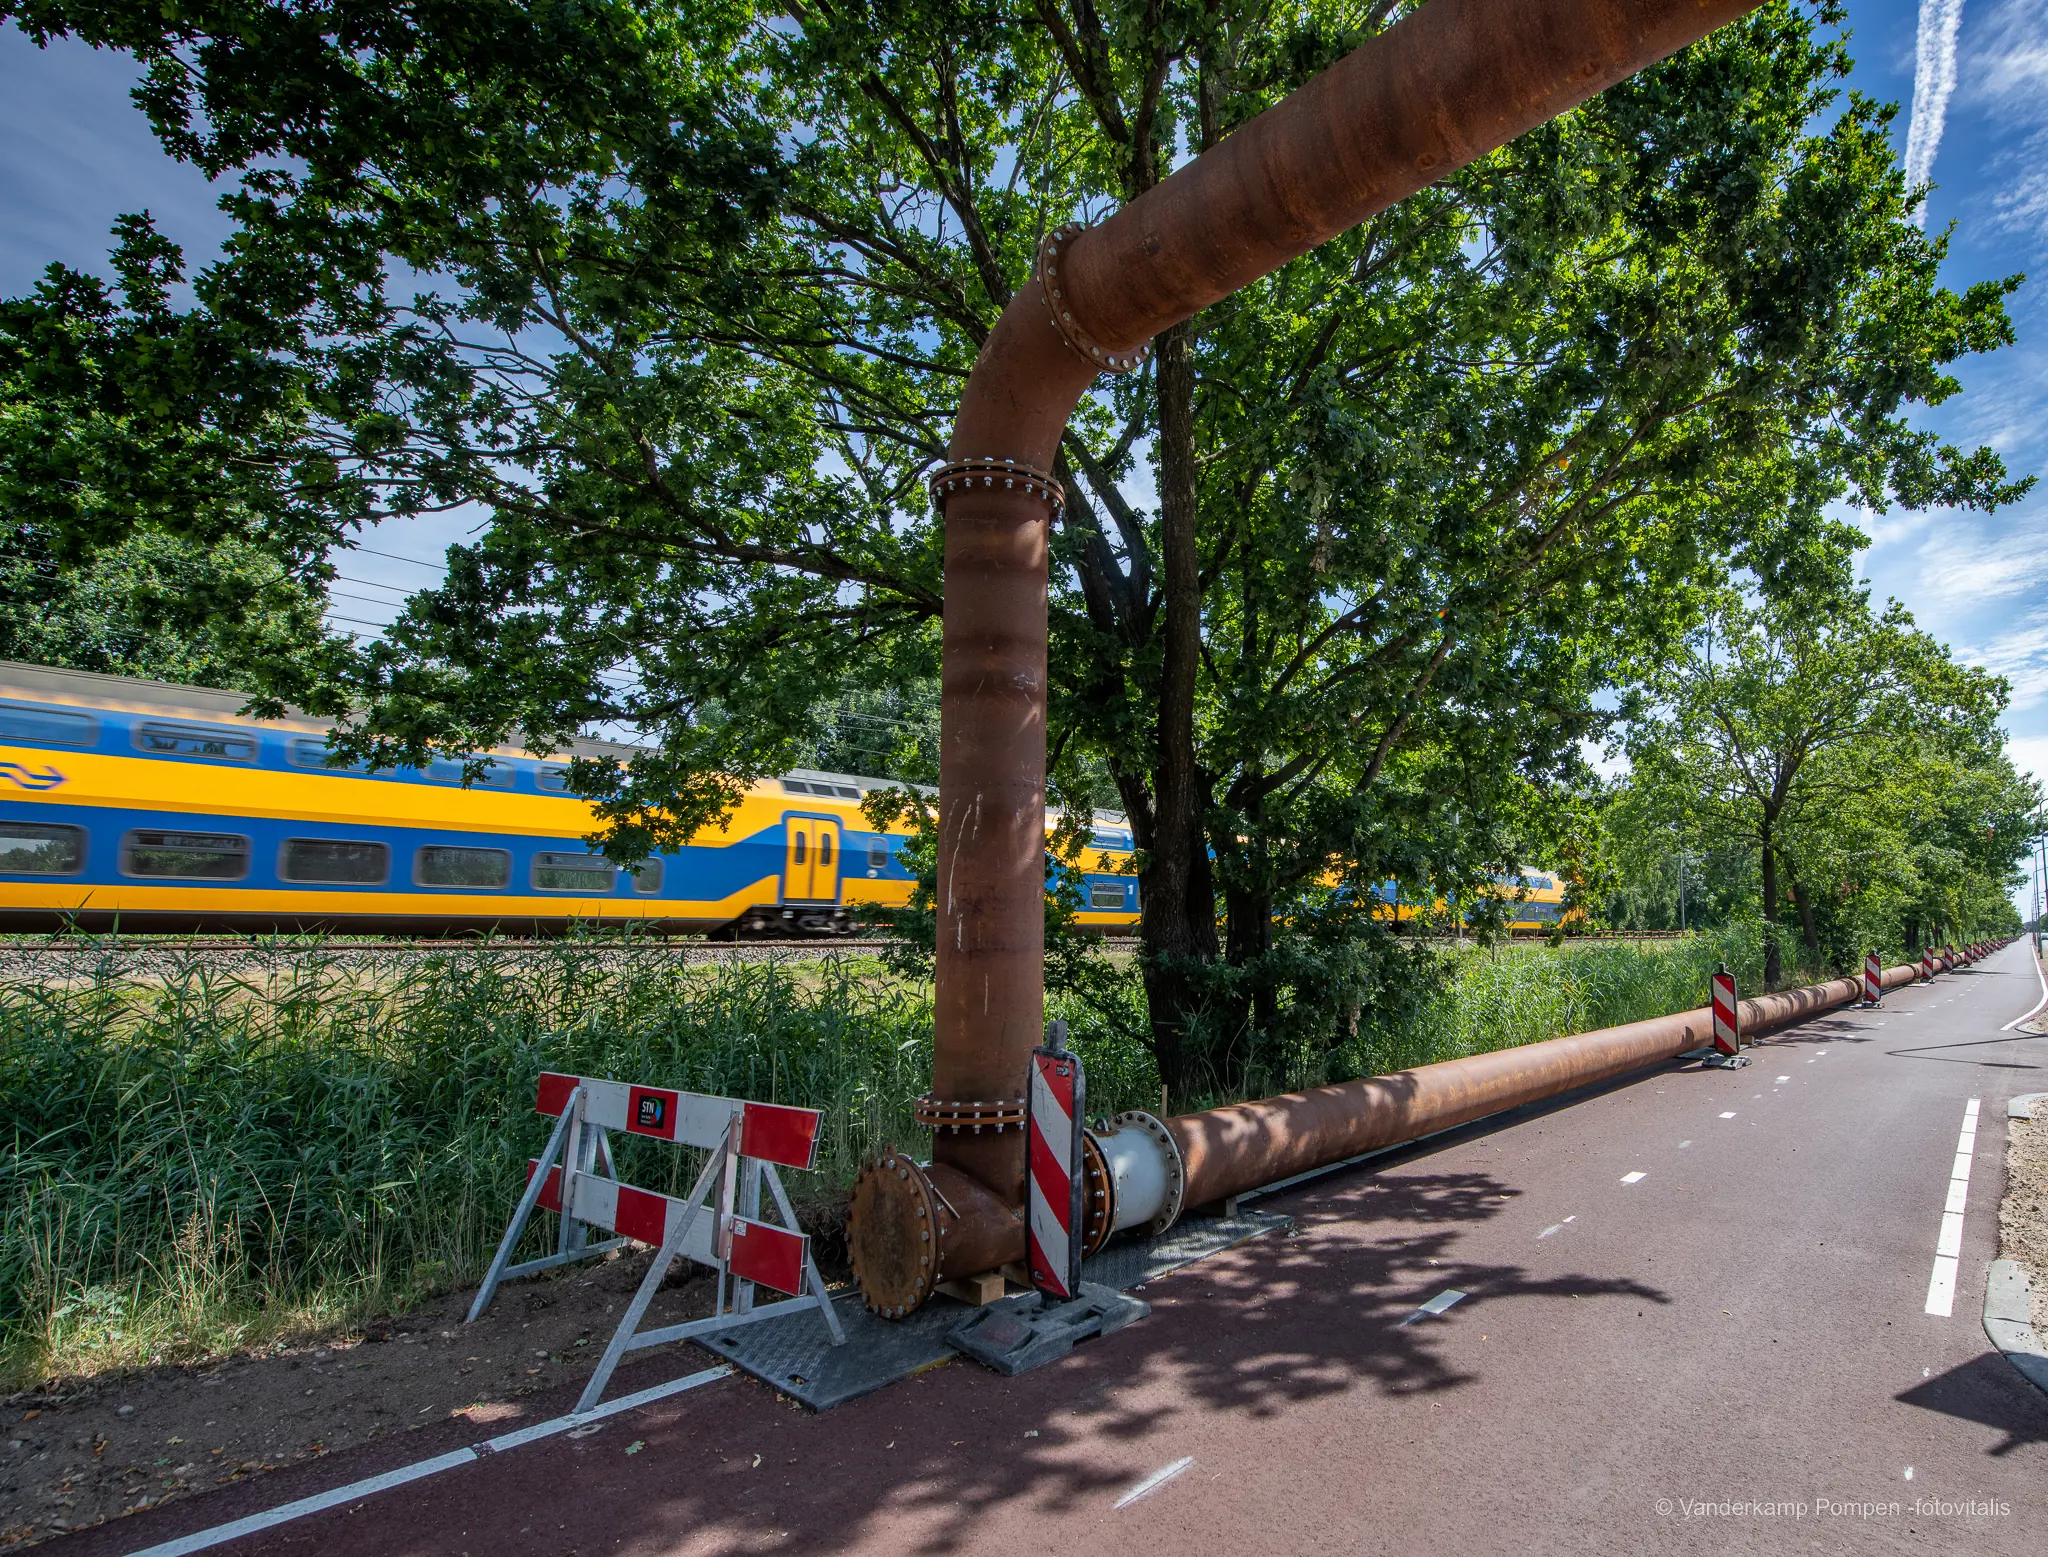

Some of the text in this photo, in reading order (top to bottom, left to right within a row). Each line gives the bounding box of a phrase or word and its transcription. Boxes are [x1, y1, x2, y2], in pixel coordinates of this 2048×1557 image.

[1124, 831, 1132, 841] 1
[1127, 884, 1134, 895] 1
[642, 1101, 655, 1114] STN
